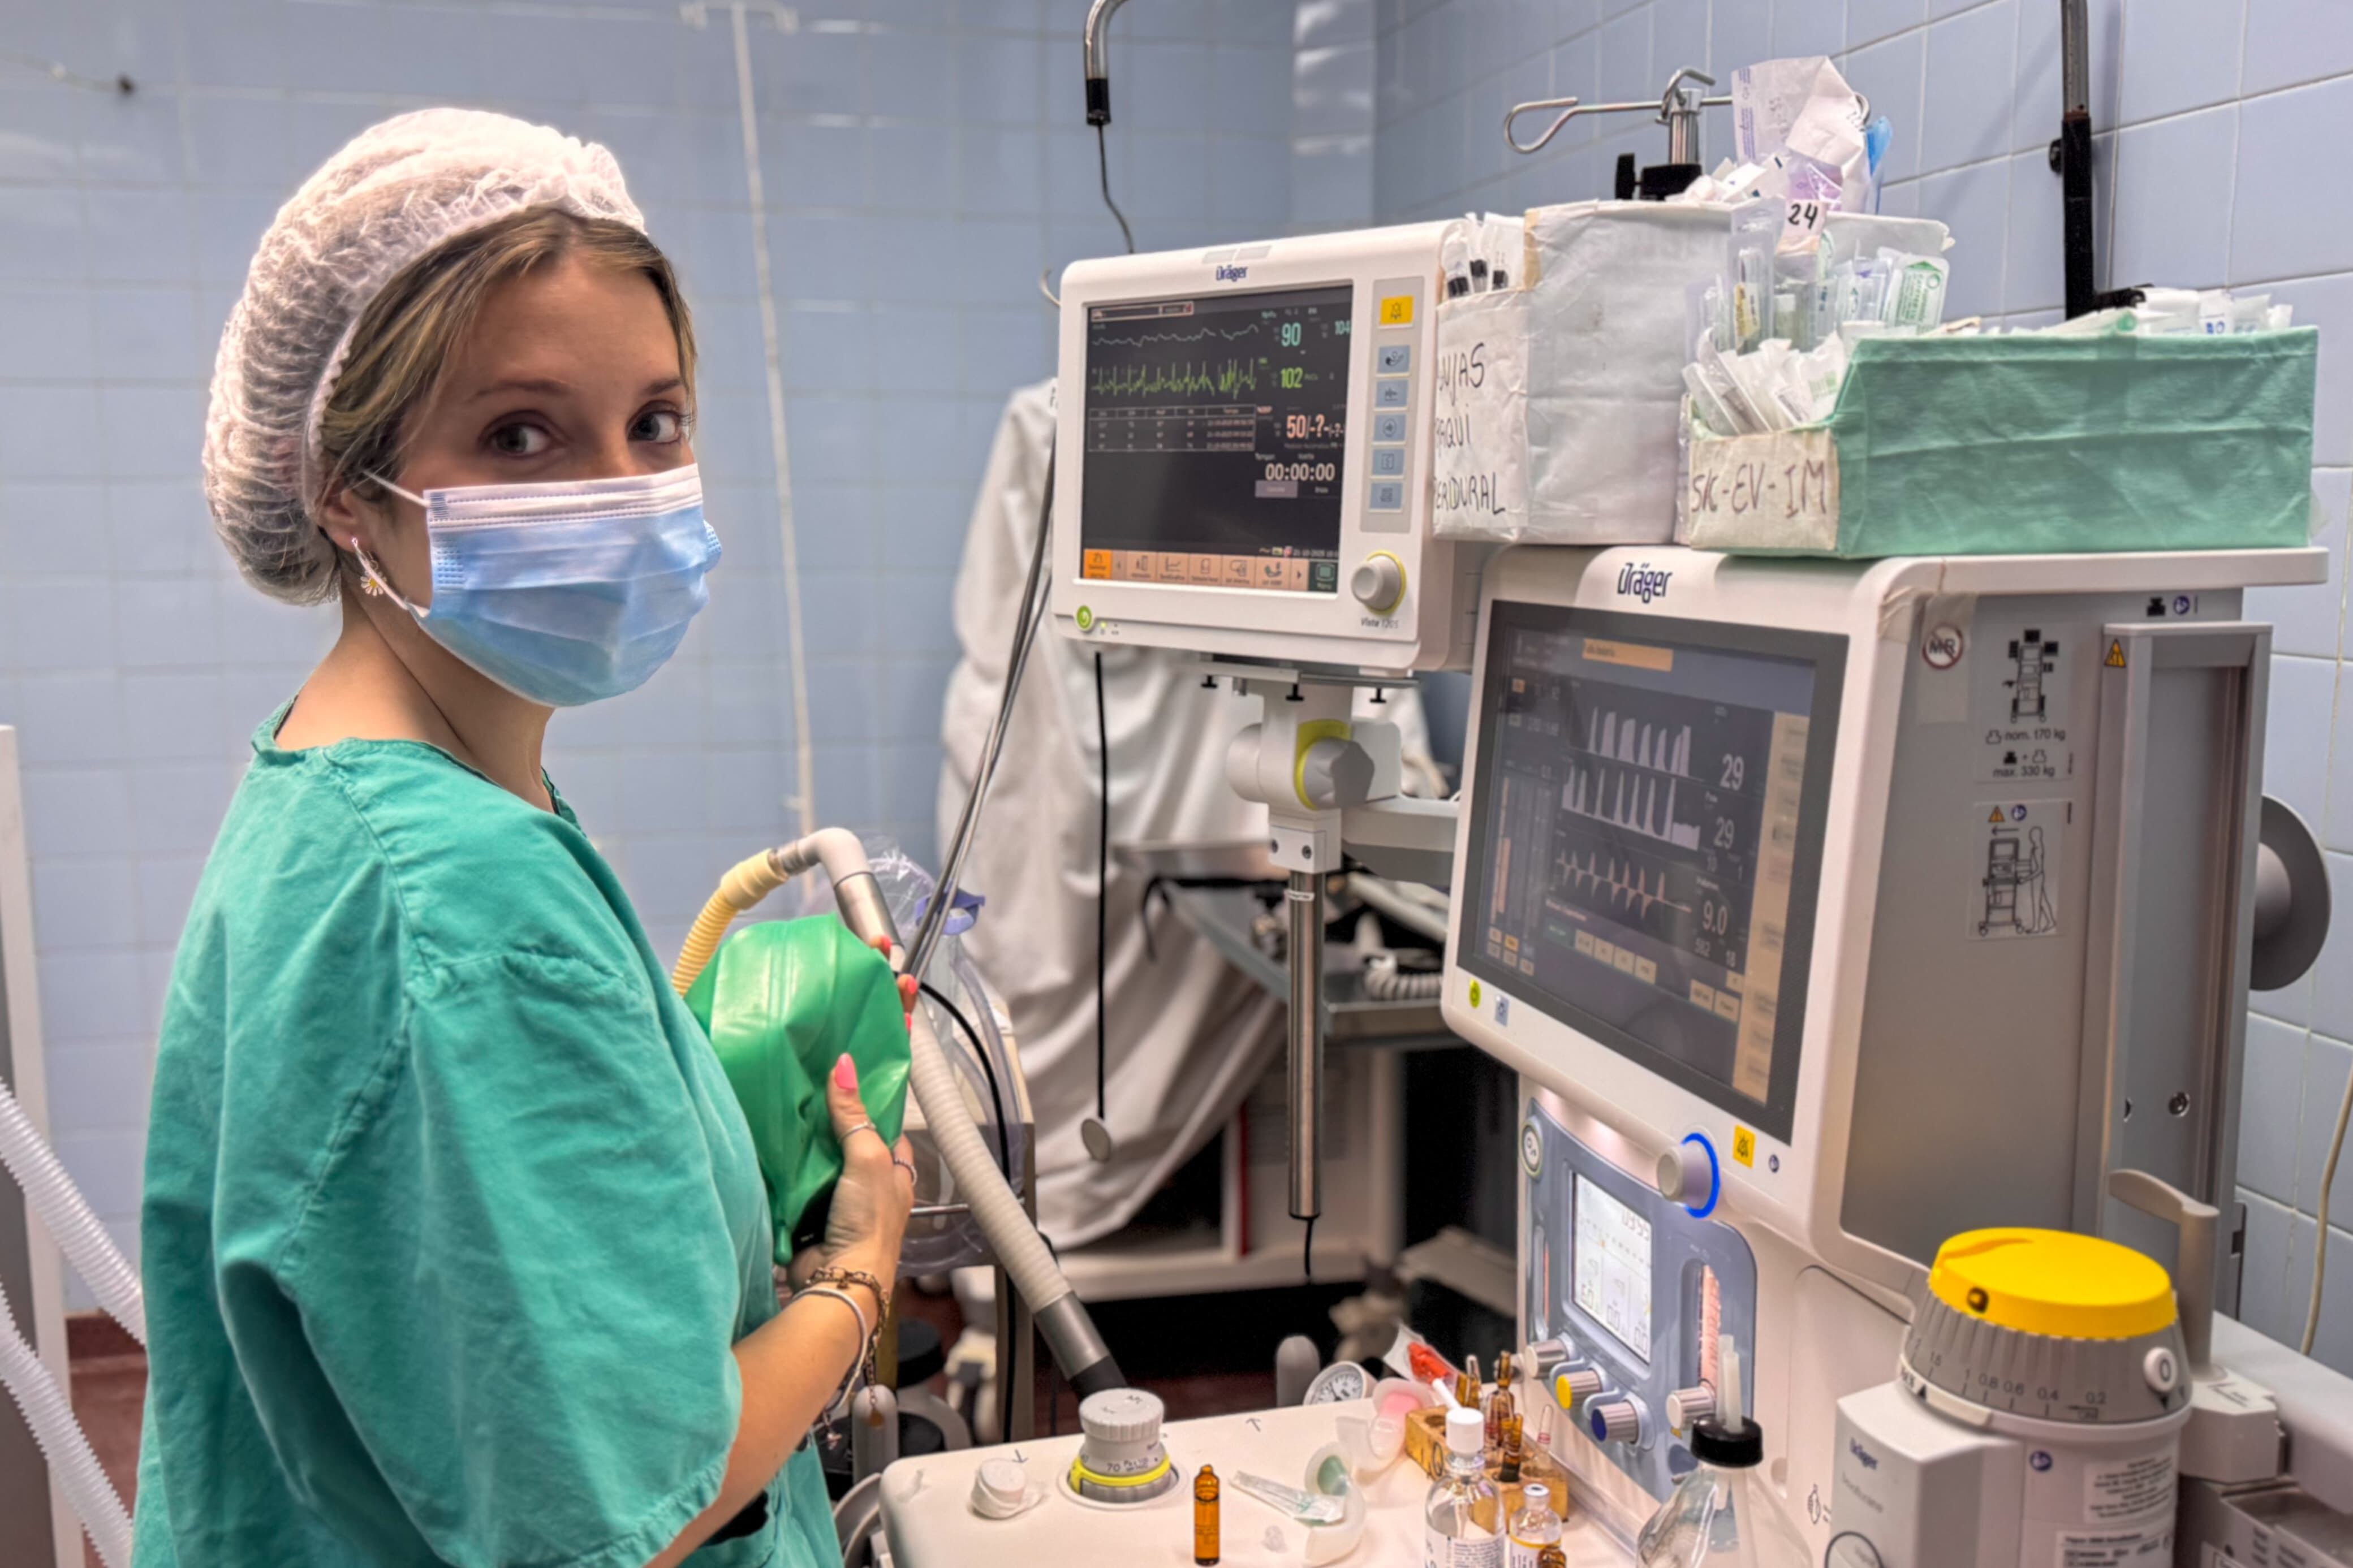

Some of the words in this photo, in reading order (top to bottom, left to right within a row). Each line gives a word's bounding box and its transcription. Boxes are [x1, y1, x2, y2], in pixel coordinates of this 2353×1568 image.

[1788, 203, 1818, 230] 24
[1281, 322, 1302, 347] 90
[1281, 367, 1303, 389] 102
[1265, 463, 1335, 481] 00:00:00
[1617, 561, 1673, 604] Dräger
[1929, 638, 1955, 654] MR
[2035, 728, 2052, 740] 170
[2054, 728, 2066, 742] kg
[1720, 753, 1744, 791] 29
[2021, 765, 2040, 777] 330
[2043, 766, 2055, 777] kg
[1713, 817, 1735, 848] 29
[1703, 900, 1727, 935] 9.0
[1107, 1463, 1121, 1472] 70
